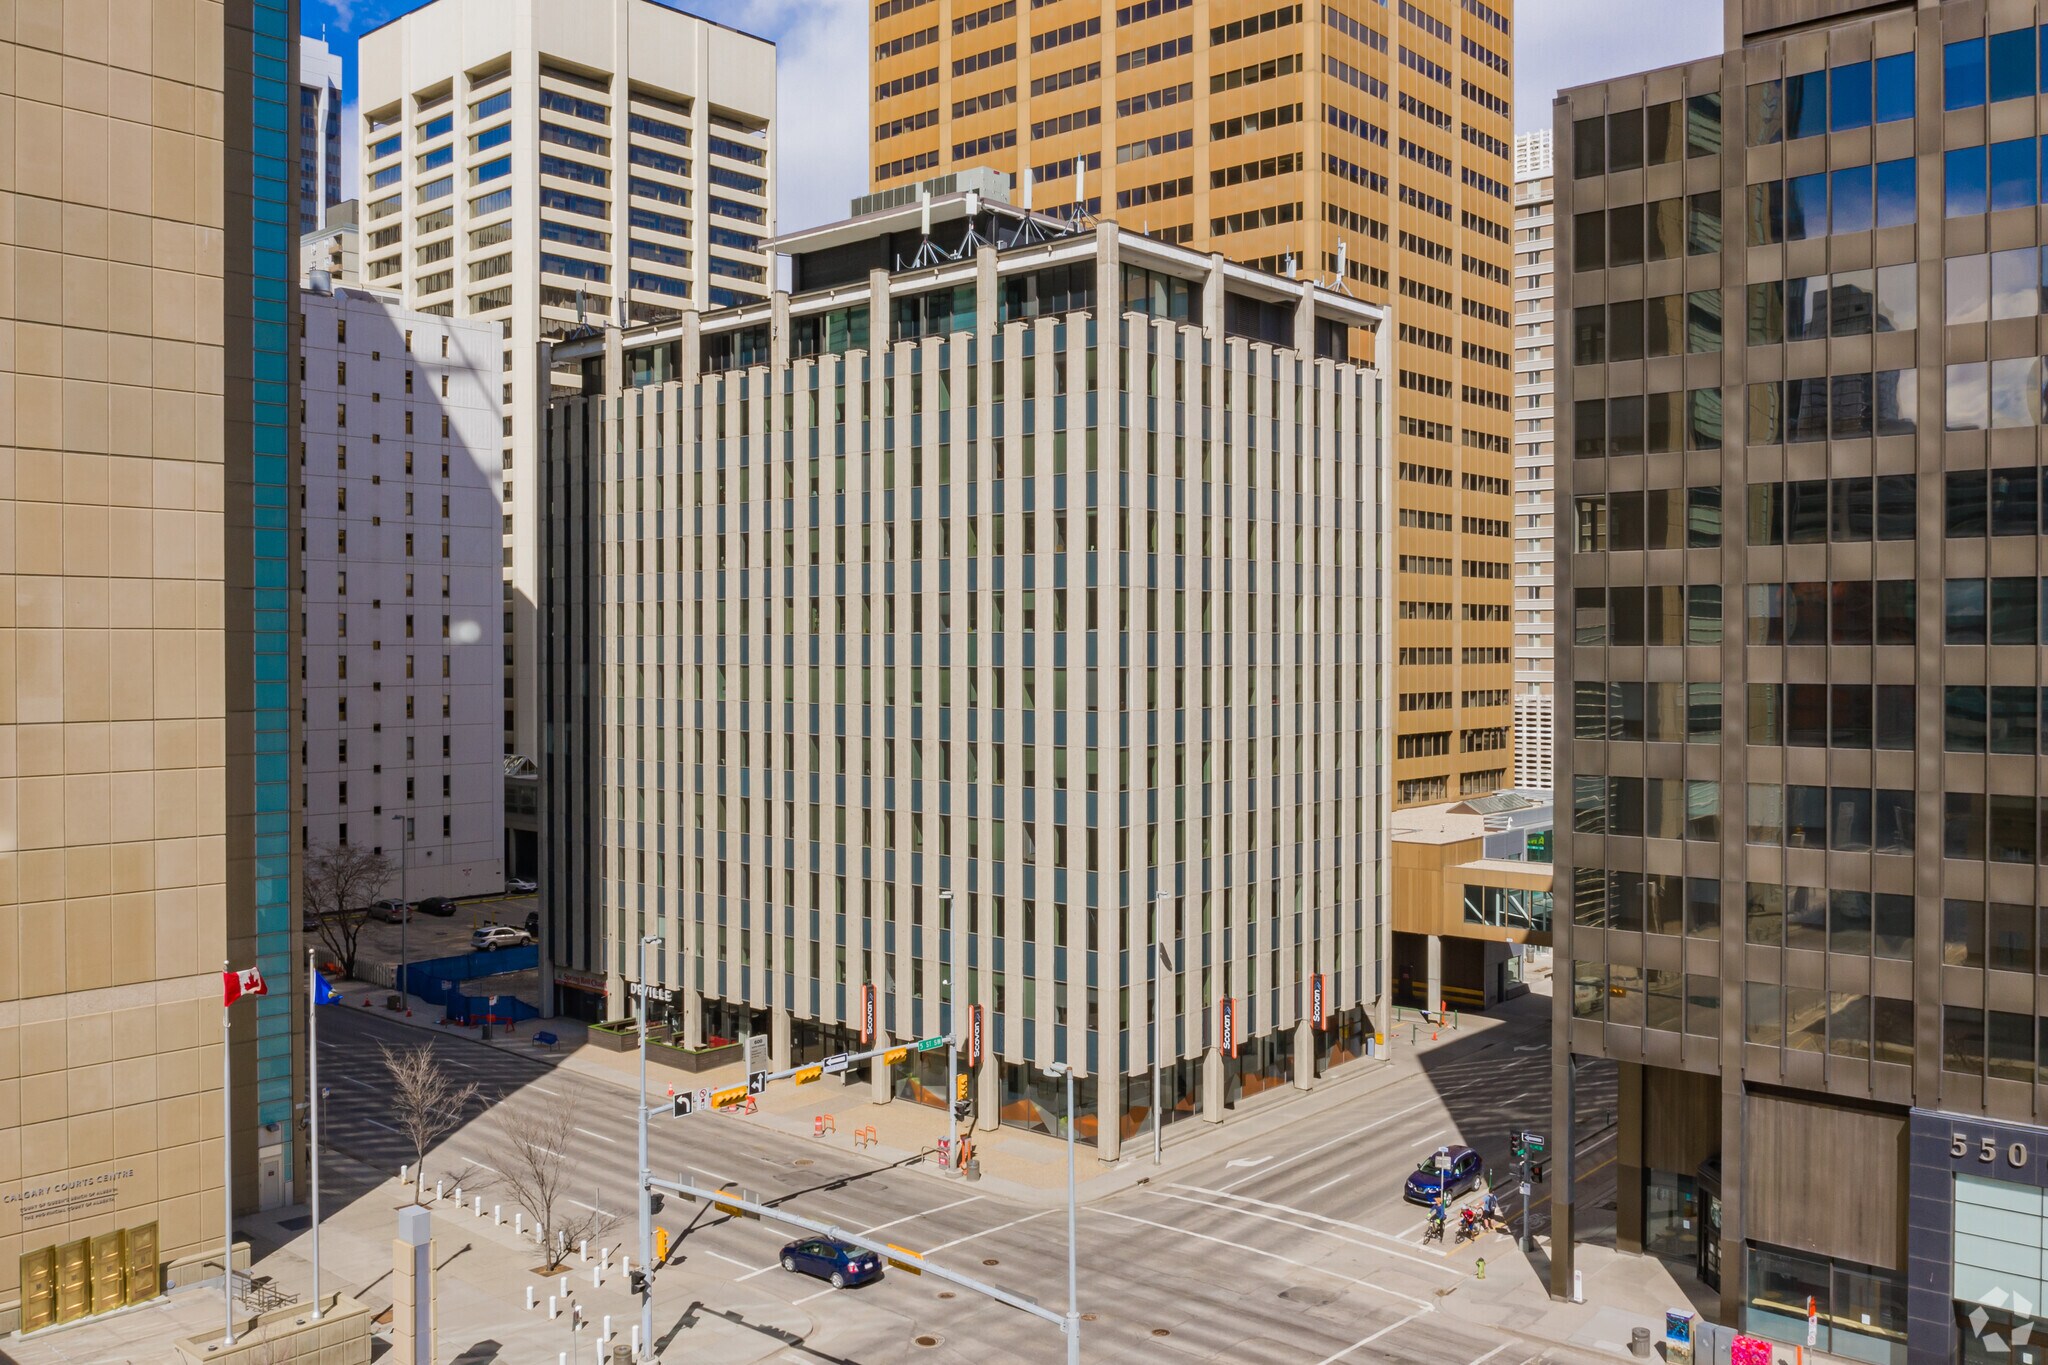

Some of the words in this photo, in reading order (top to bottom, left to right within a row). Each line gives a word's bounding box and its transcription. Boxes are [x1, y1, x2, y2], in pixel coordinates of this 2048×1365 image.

[630, 983, 673, 1002] DEVILLE
[1313, 989, 1321, 1022] Scovan
[926, 1040, 932, 1048] ST
[1223, 1014, 1231, 1049] Scovan
[1950, 1132, 2028, 1167] 550
[3, 1187, 51, 1204] CALGARY
[54, 1177, 94, 1193] COURTS
[97, 1169, 134, 1184] CENTRE
